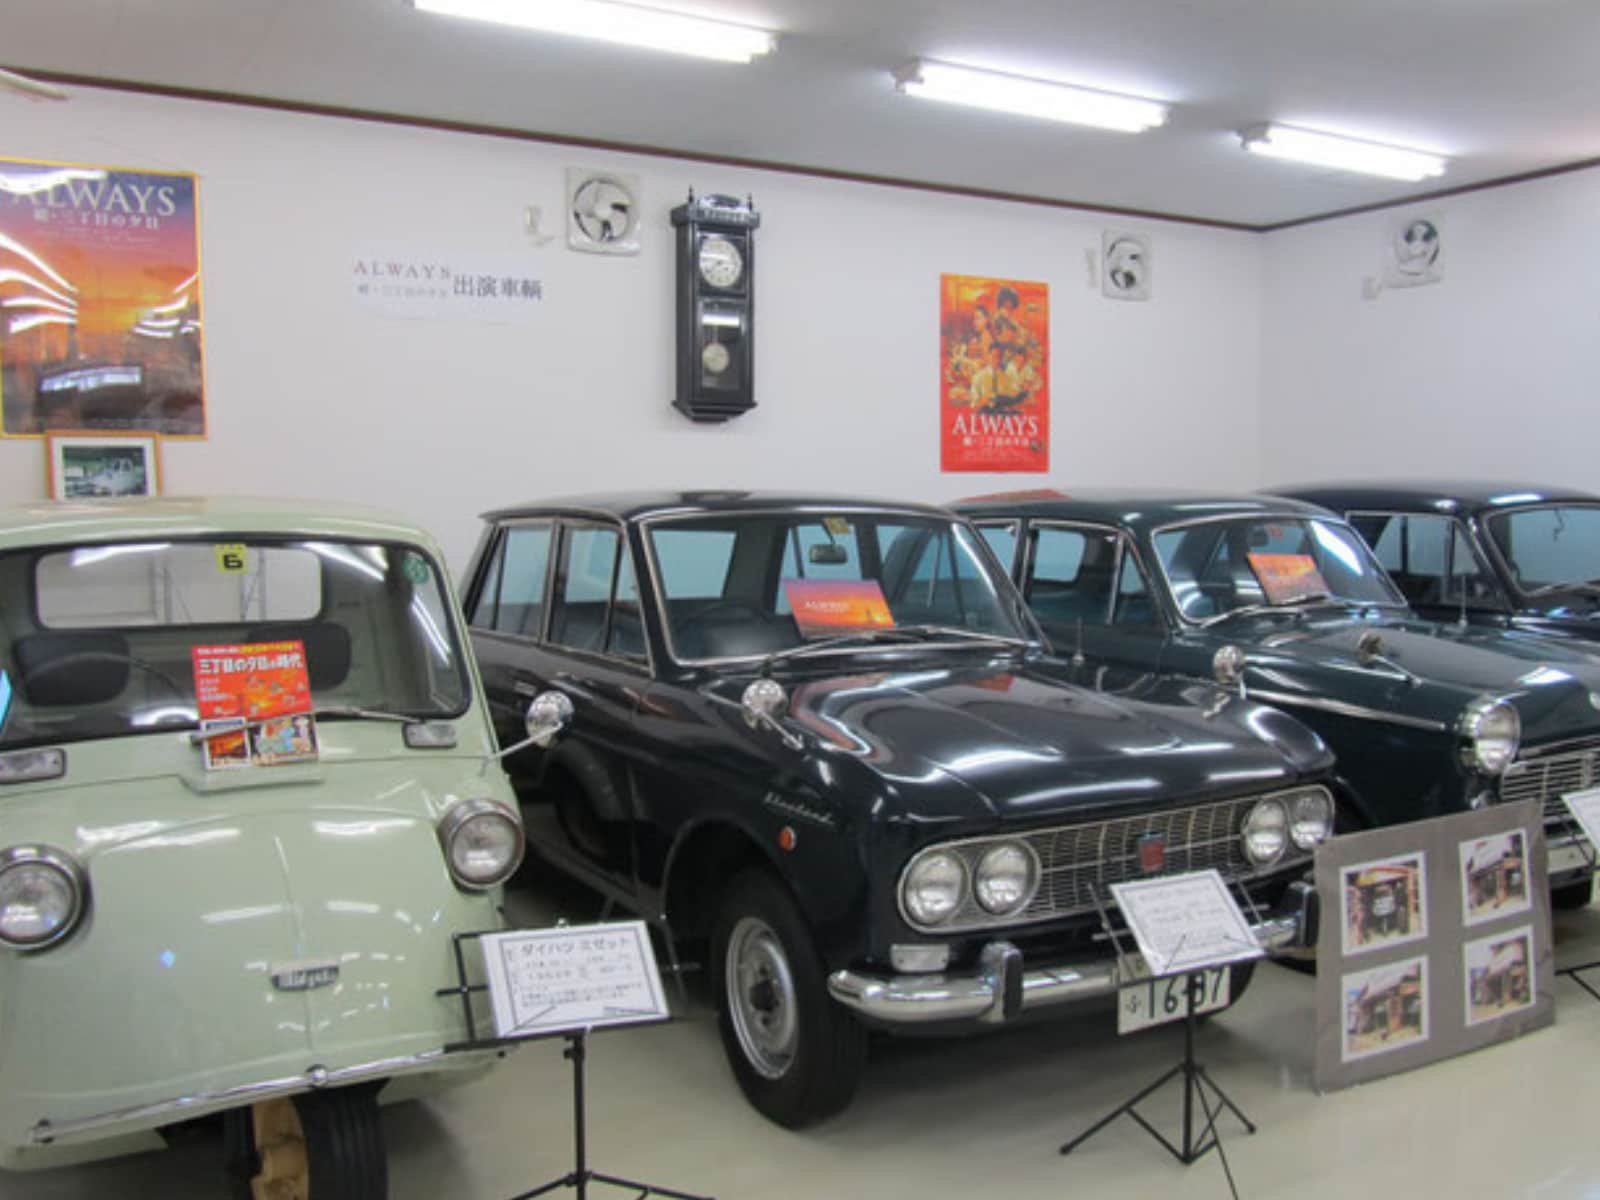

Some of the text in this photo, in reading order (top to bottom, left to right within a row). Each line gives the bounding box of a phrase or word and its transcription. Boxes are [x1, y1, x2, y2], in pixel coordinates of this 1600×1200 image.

[353, 259, 451, 279] ALWAYS
[952, 412, 1039, 437] ALWAYS
[223, 553, 244, 570] 6
